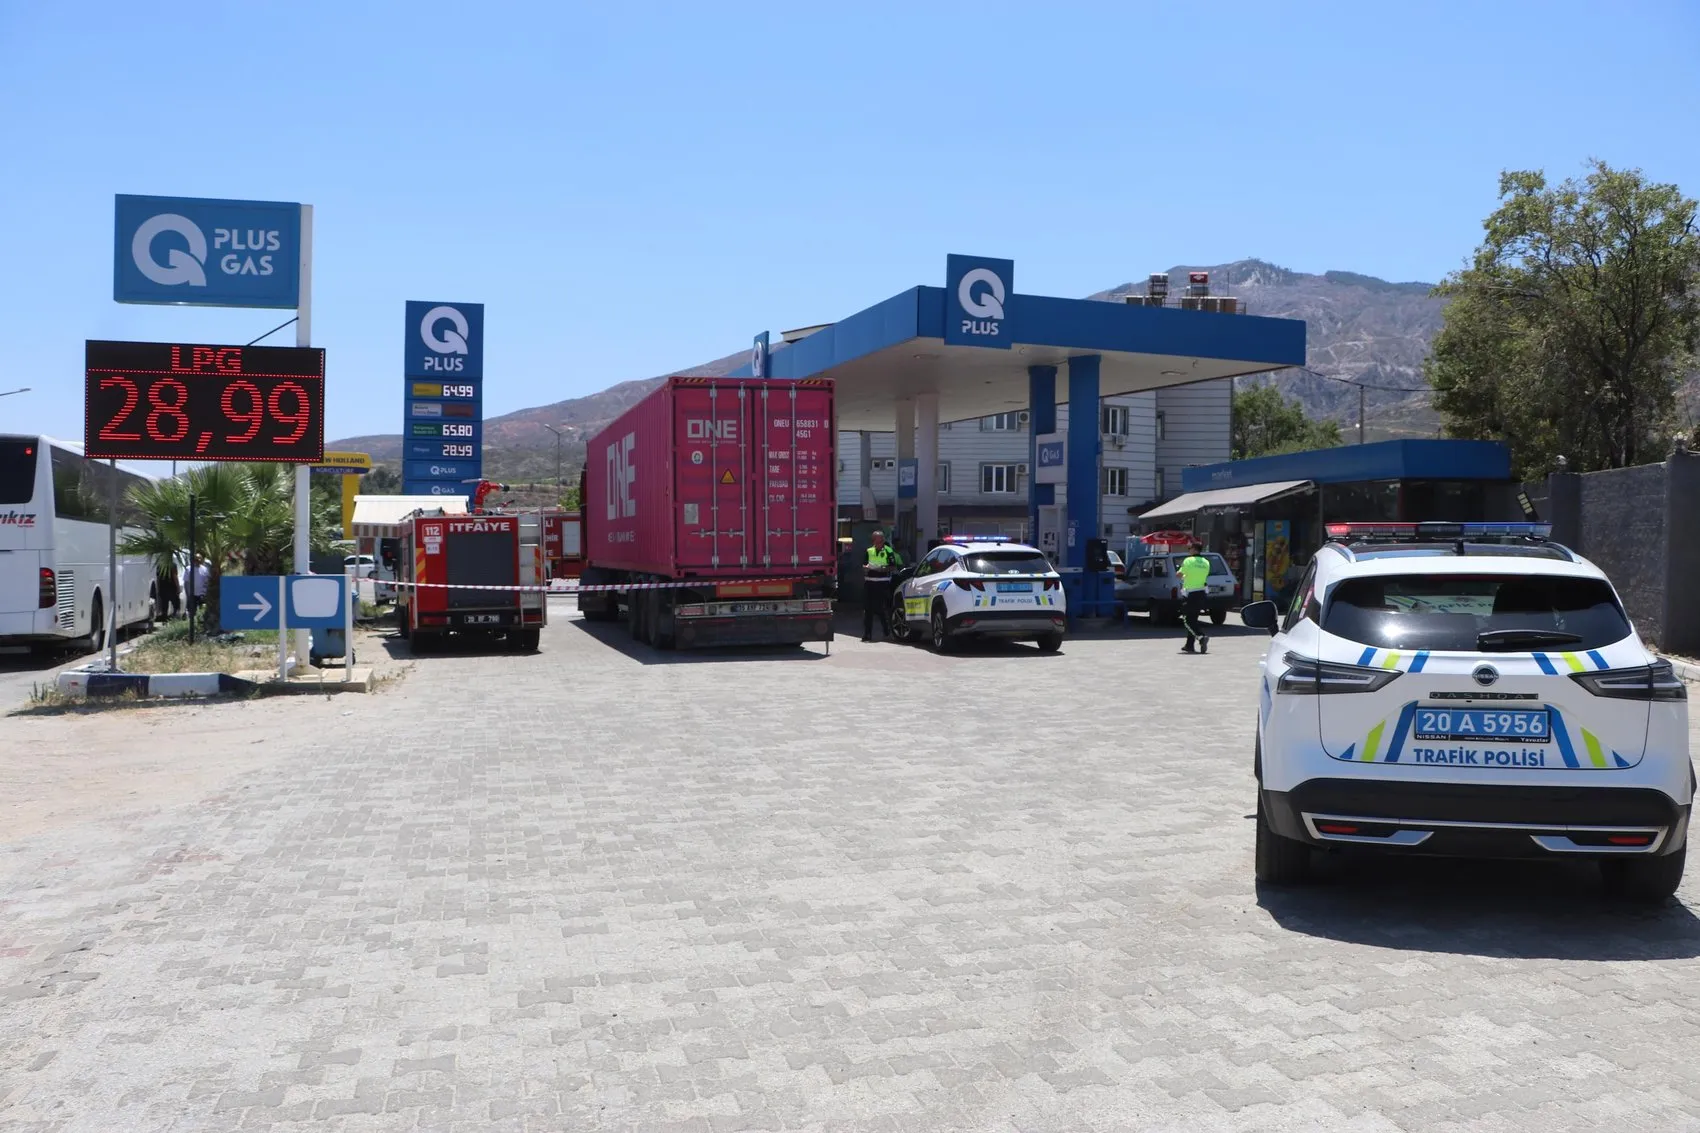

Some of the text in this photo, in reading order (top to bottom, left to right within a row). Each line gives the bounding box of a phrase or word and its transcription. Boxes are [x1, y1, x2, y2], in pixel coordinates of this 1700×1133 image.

[132, 213, 207, 287] Q
[214, 228, 280, 251] PLUS
[220, 254, 274, 276] GAS
[958, 268, 1005, 320] Q
[420, 306, 468, 354] Q
[962, 320, 999, 336] PLUS
[172, 346, 242, 372] LPG
[424, 356, 464, 372] PLUS
[99, 376, 310, 452] 28,99
[687, 420, 737, 438] ONE
[607, 432, 636, 520] ONE
[425, 526, 440, 536] 112
[1422, 713, 1542, 733] 20 A 5956
[1413, 747, 1544, 766] TRAFİK POLİSİ
